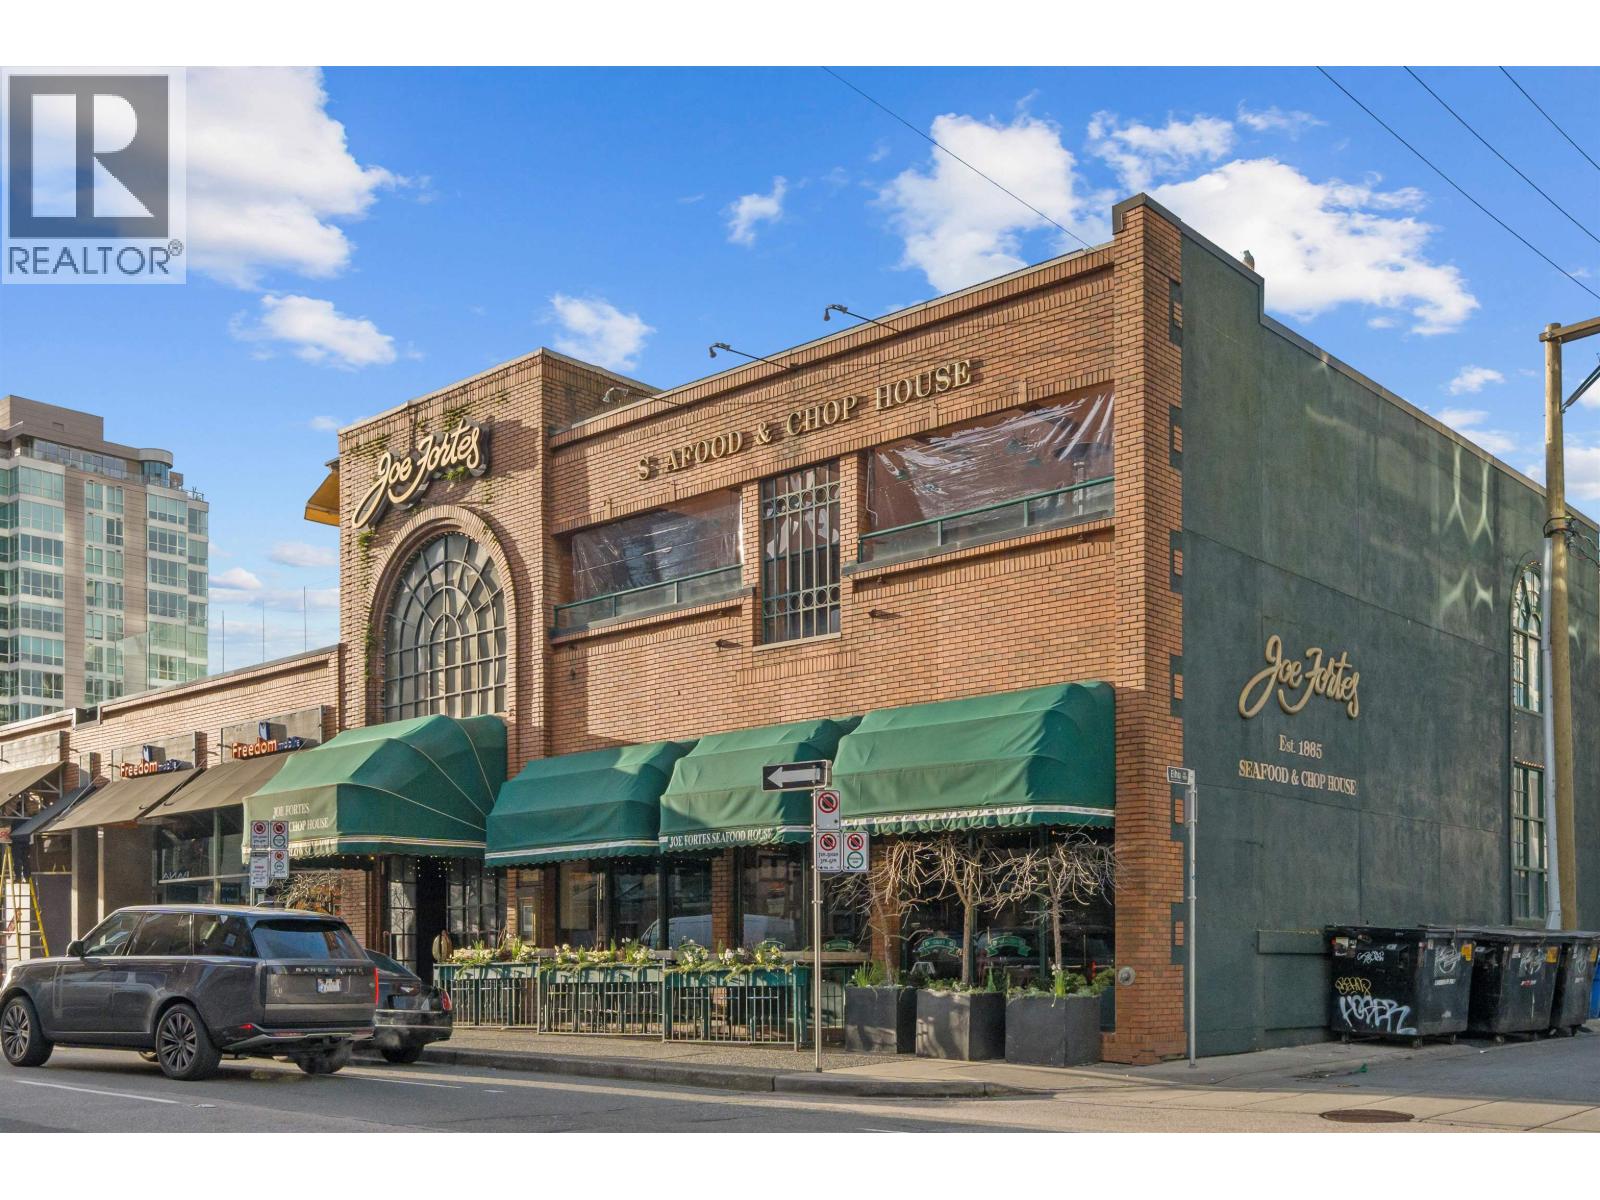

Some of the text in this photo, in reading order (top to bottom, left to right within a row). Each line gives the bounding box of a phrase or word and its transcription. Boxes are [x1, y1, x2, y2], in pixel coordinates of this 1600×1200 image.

[756, 421, 772, 445] &
[786, 395, 858, 436] CHOP
[875, 359, 973, 410] HOUSE
[352, 418, 481, 530] Joe Fortes
[1238, 634, 1360, 719] Joe Fortes
[231, 736, 277, 759] Freedom
[1279, 734, 1323, 759] Est. 1885
[119, 759, 158, 778] Freedom
[1239, 759, 1357, 796] SEAFOOD & CHOP HOUSE
[285, 802, 311, 817] FORTES
[307, 817, 329, 830] HOUSE
[669, 836, 684, 849] JOE
[684, 832, 711, 846] FORTES
[711, 830, 746, 844] SEAFOOD
